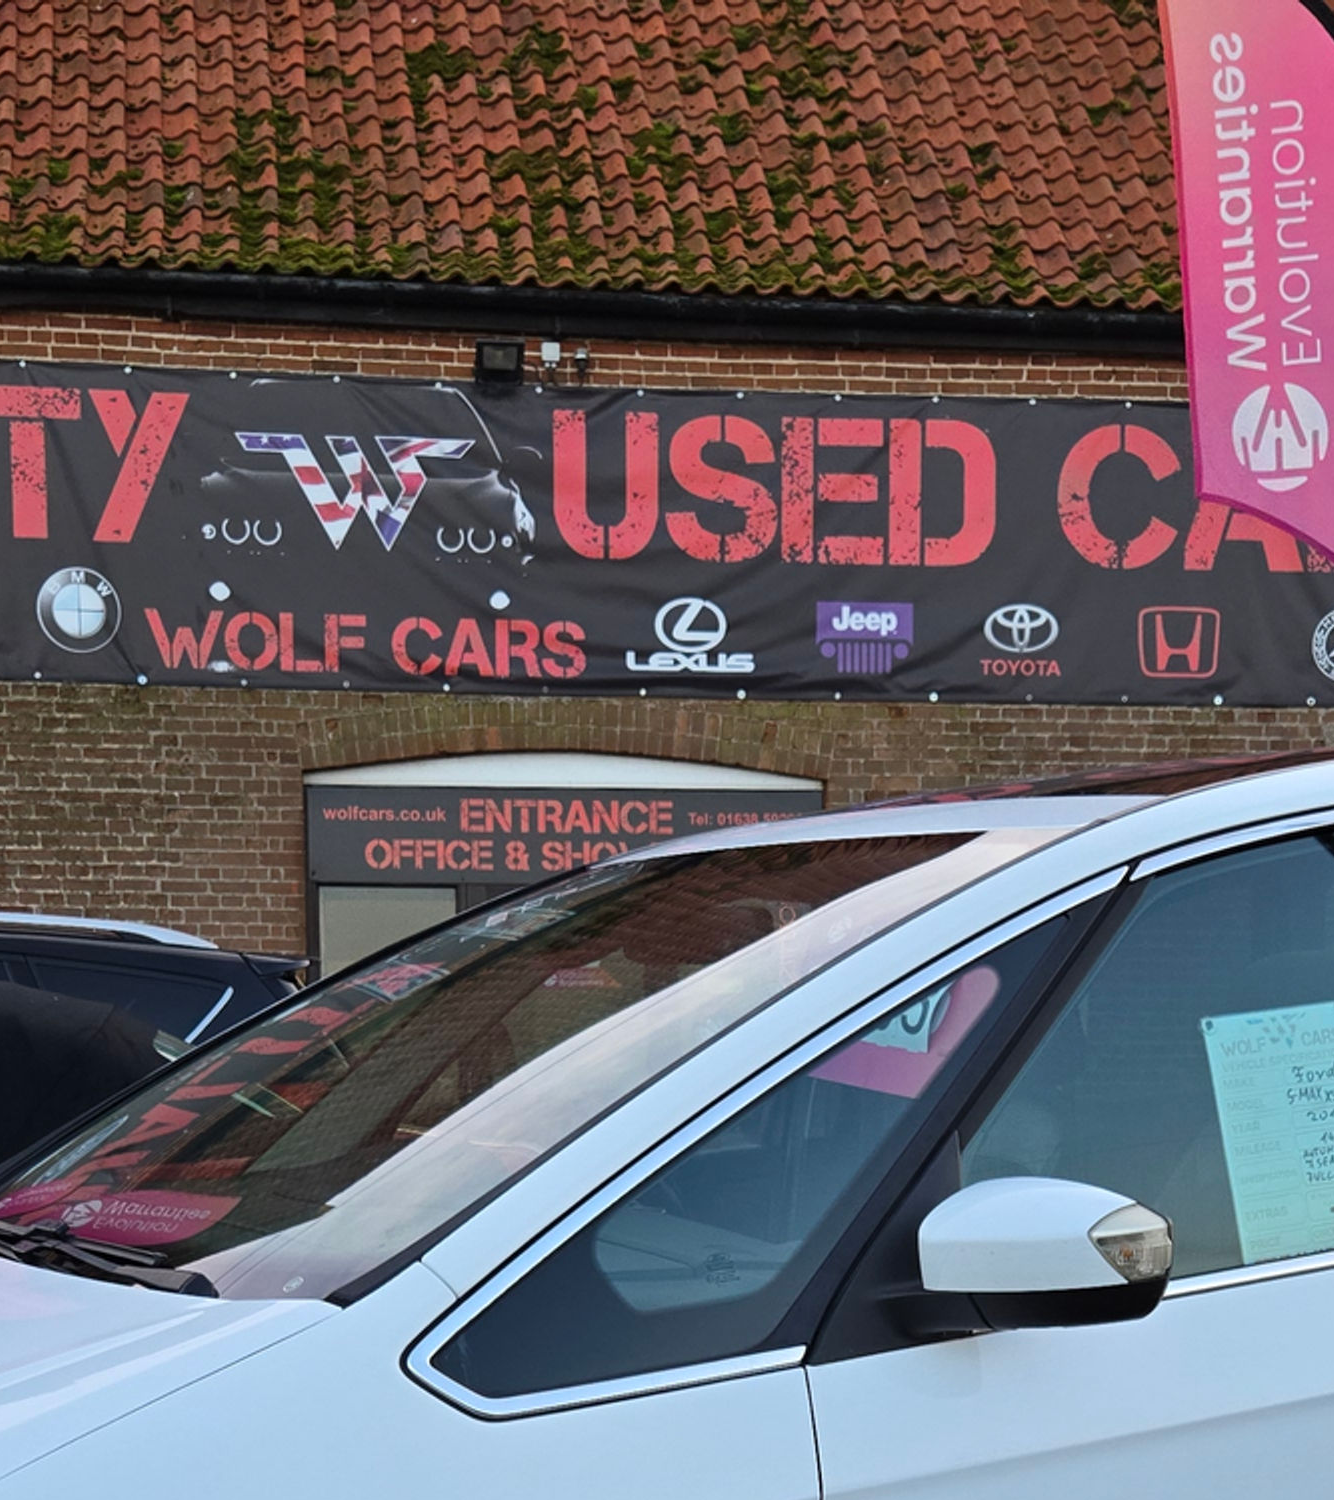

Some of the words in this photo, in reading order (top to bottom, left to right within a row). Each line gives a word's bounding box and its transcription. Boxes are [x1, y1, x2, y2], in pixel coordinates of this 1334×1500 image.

[552, 409, 997, 567] USED
[832, 605, 898, 636] Jeep
[144, 607, 368, 673] WOLF
[391, 617, 586, 678] CARS
[625, 651, 756, 674] LEXUS
[980, 658, 1062, 677] TOYOTA
[323, 806, 447, 822] wolfcars.co.uk
[459, 798, 674, 835] ENTRANCE
[688, 812, 713, 826] Tel:
[717, 812, 759, 827] 01638
[364, 839, 494, 871] OFFICE
[505, 840, 530, 871] &
[1220, 1037, 1266, 1058] WOLF
